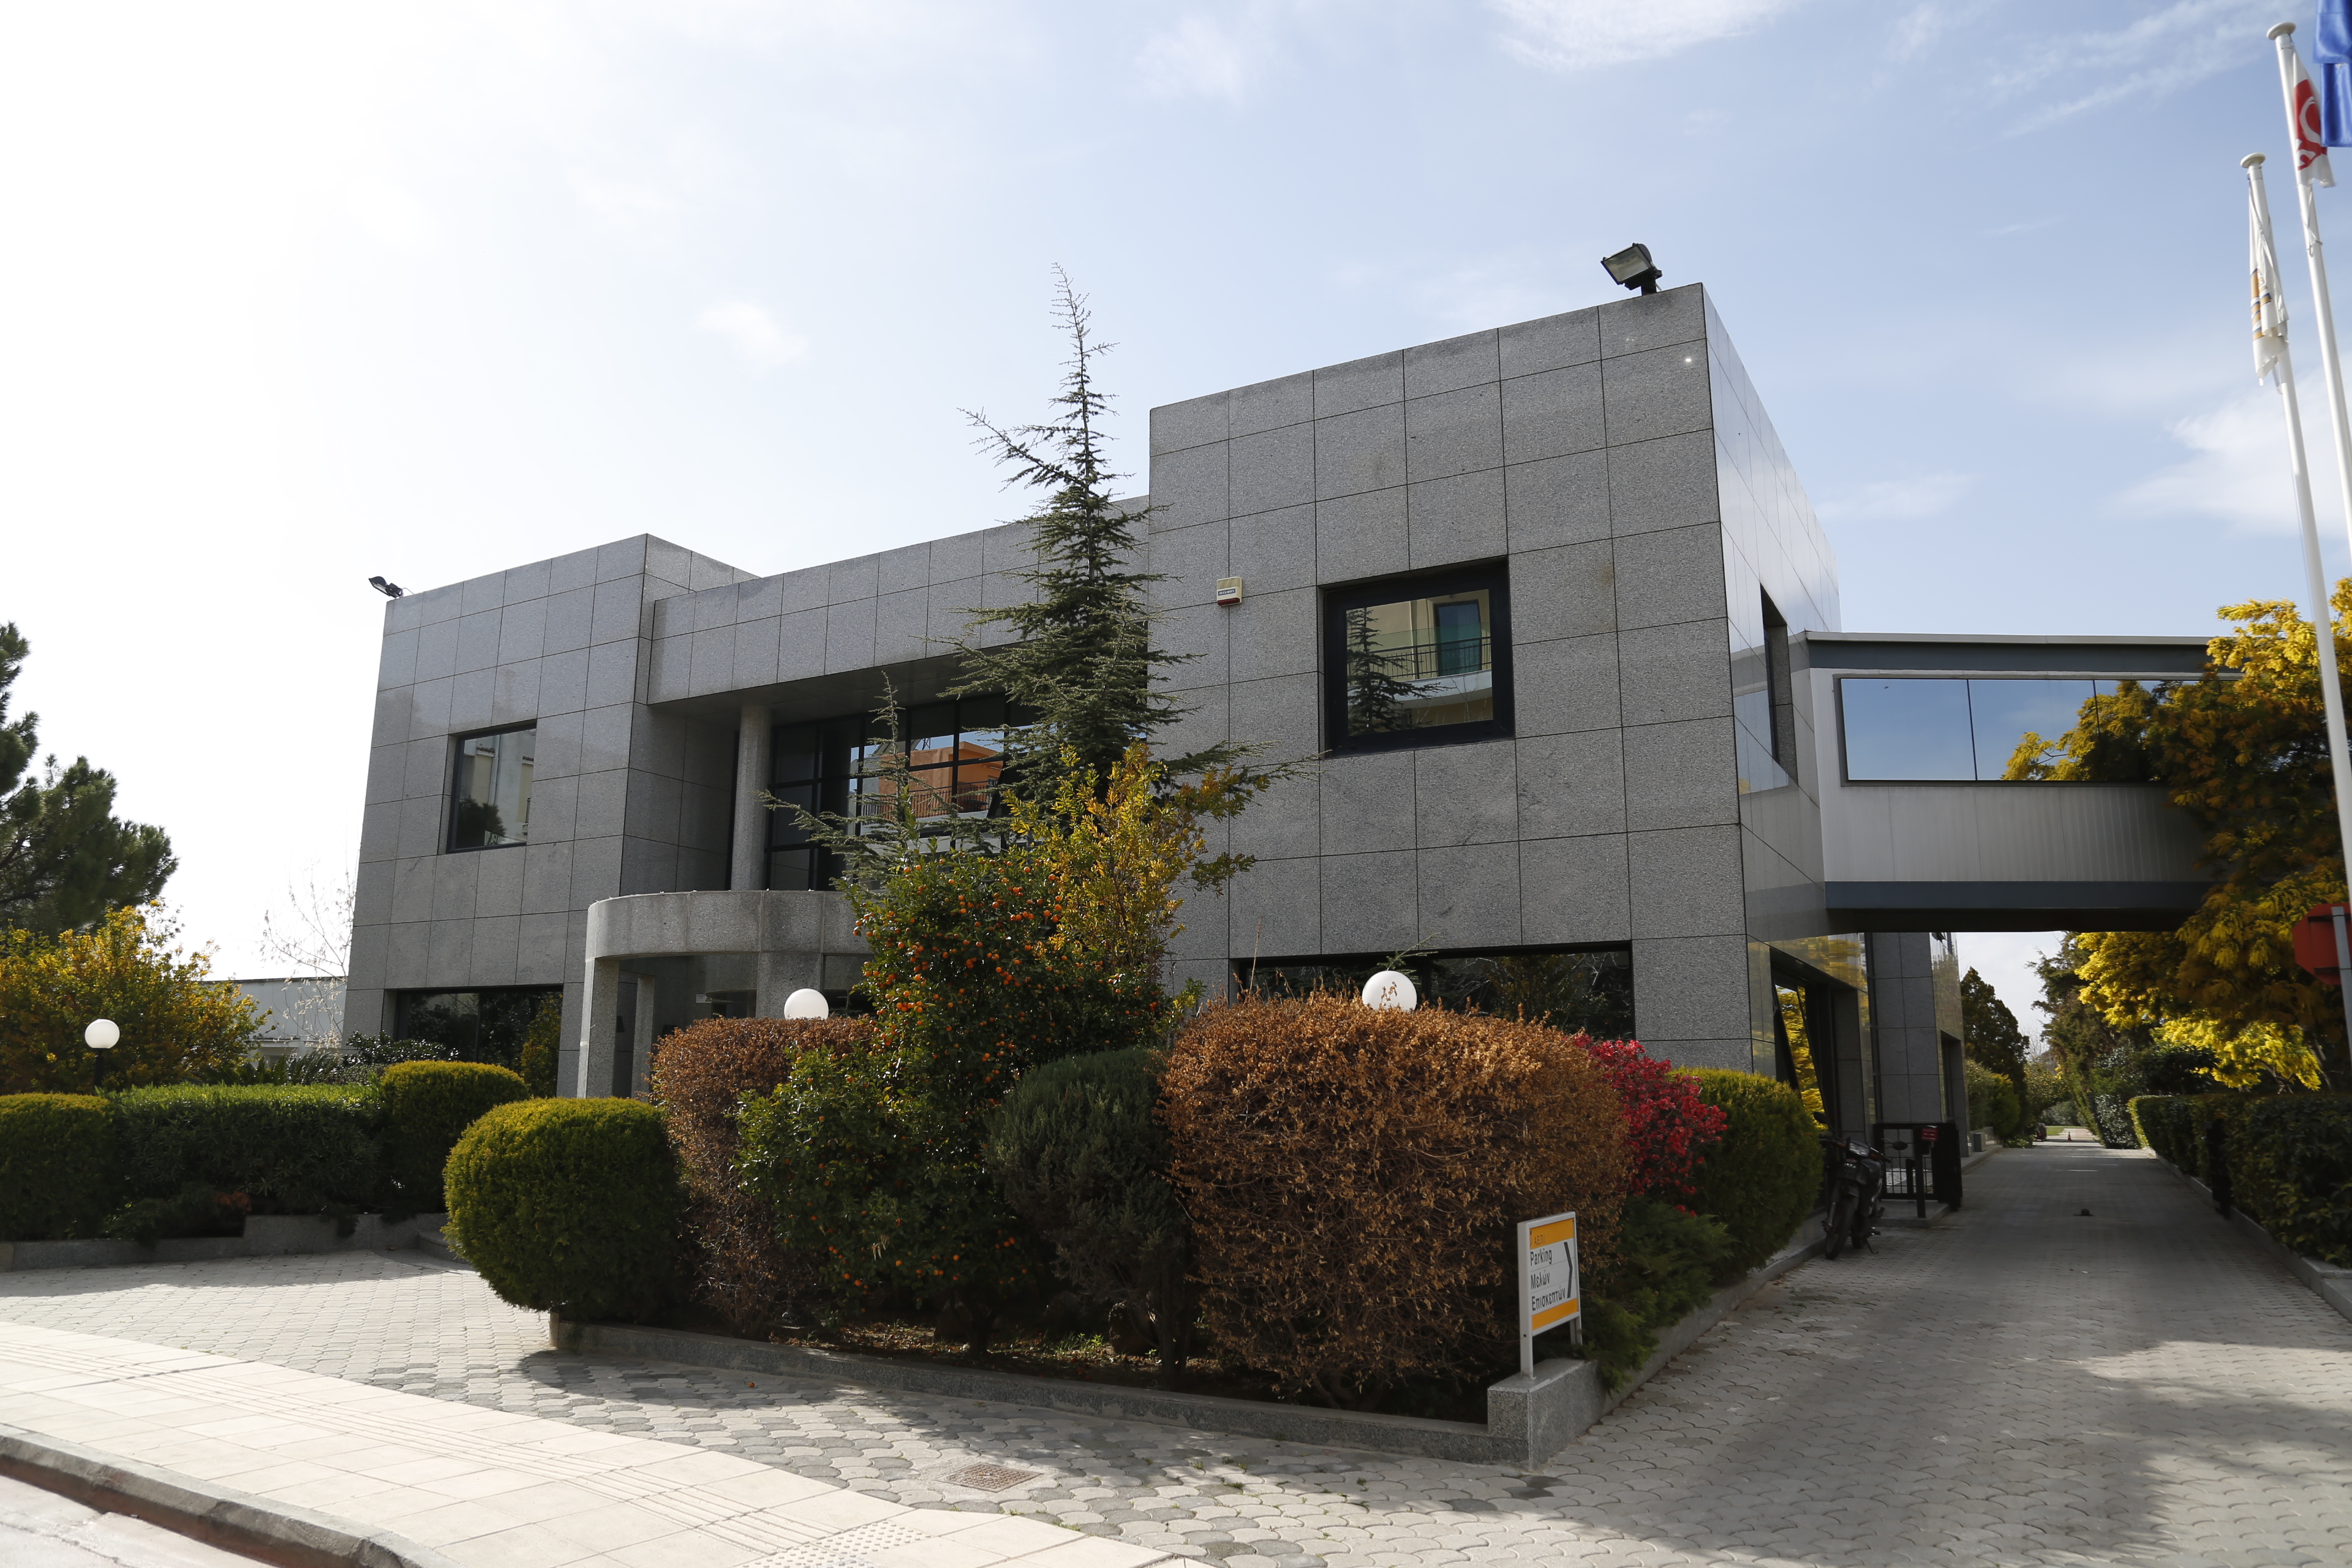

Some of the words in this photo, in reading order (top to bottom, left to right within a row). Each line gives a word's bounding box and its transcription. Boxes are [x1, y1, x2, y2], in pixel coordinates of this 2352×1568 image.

[1531, 1248, 1552, 1266] Parking
[1531, 1270, 1550, 1289] Μελών
[1532, 1285, 1566, 1311] Επισκεπτών
